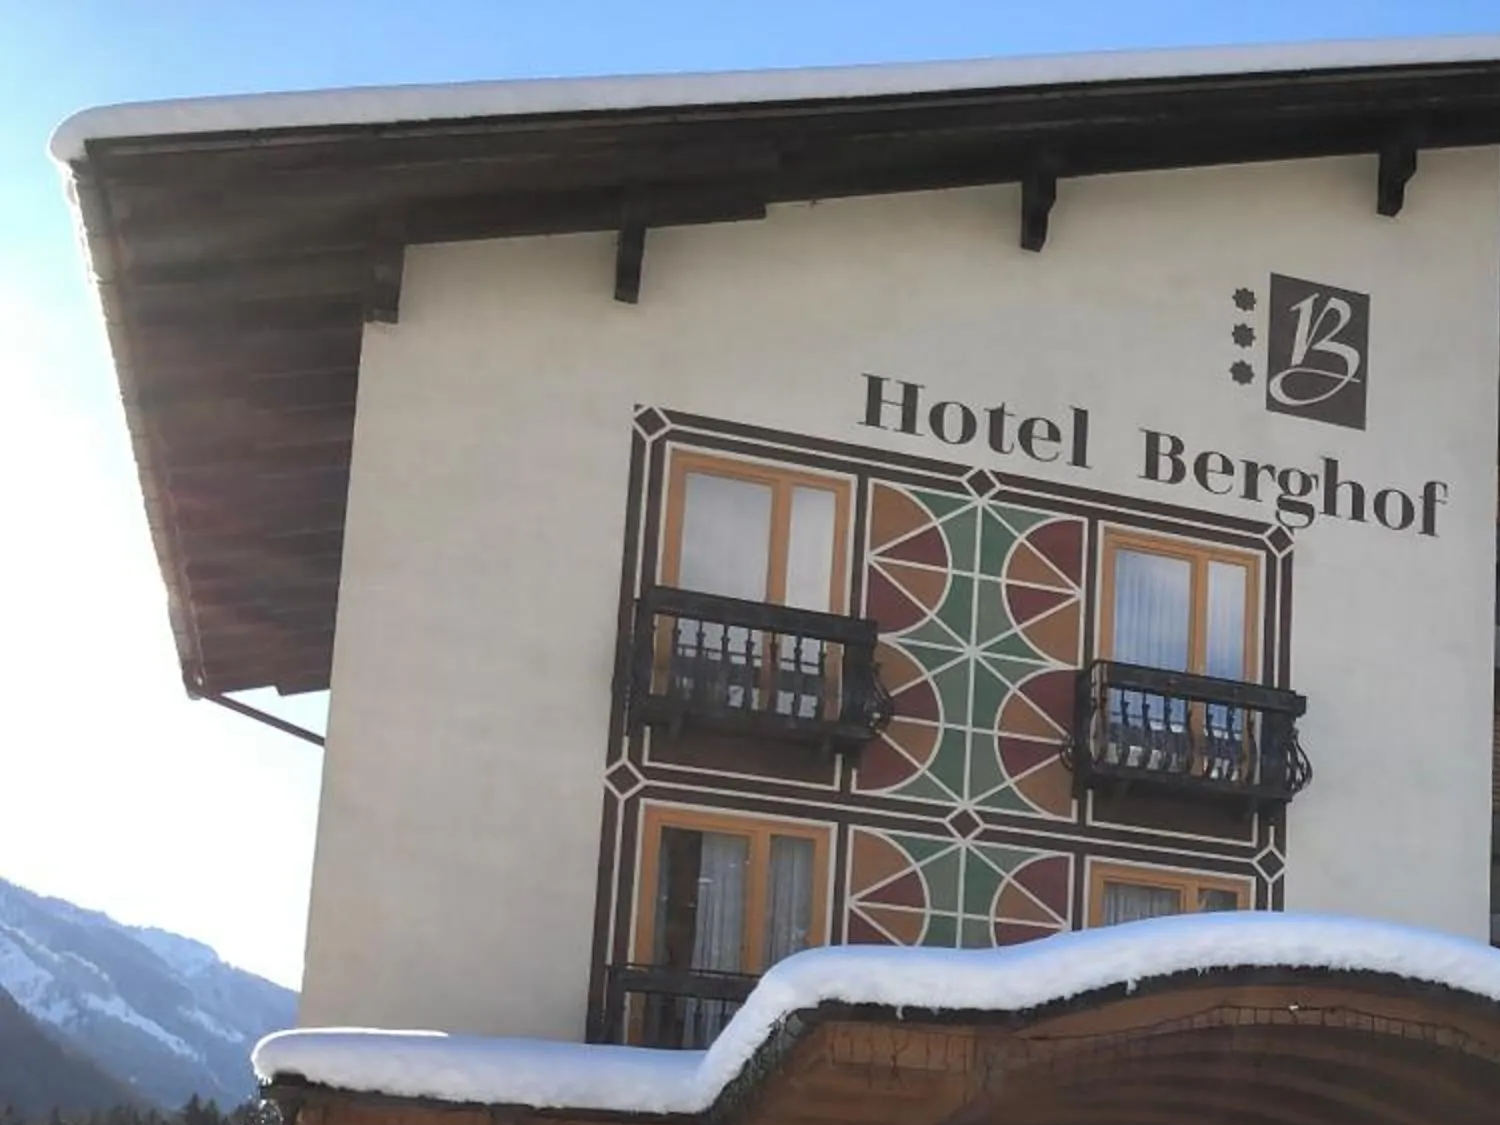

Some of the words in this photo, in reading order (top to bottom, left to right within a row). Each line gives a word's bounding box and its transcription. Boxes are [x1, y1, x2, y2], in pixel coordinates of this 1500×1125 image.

[1268, 293, 1361, 406] B
[858, 373, 1092, 469] Hotel
[1138, 428, 1449, 538] Berghof
